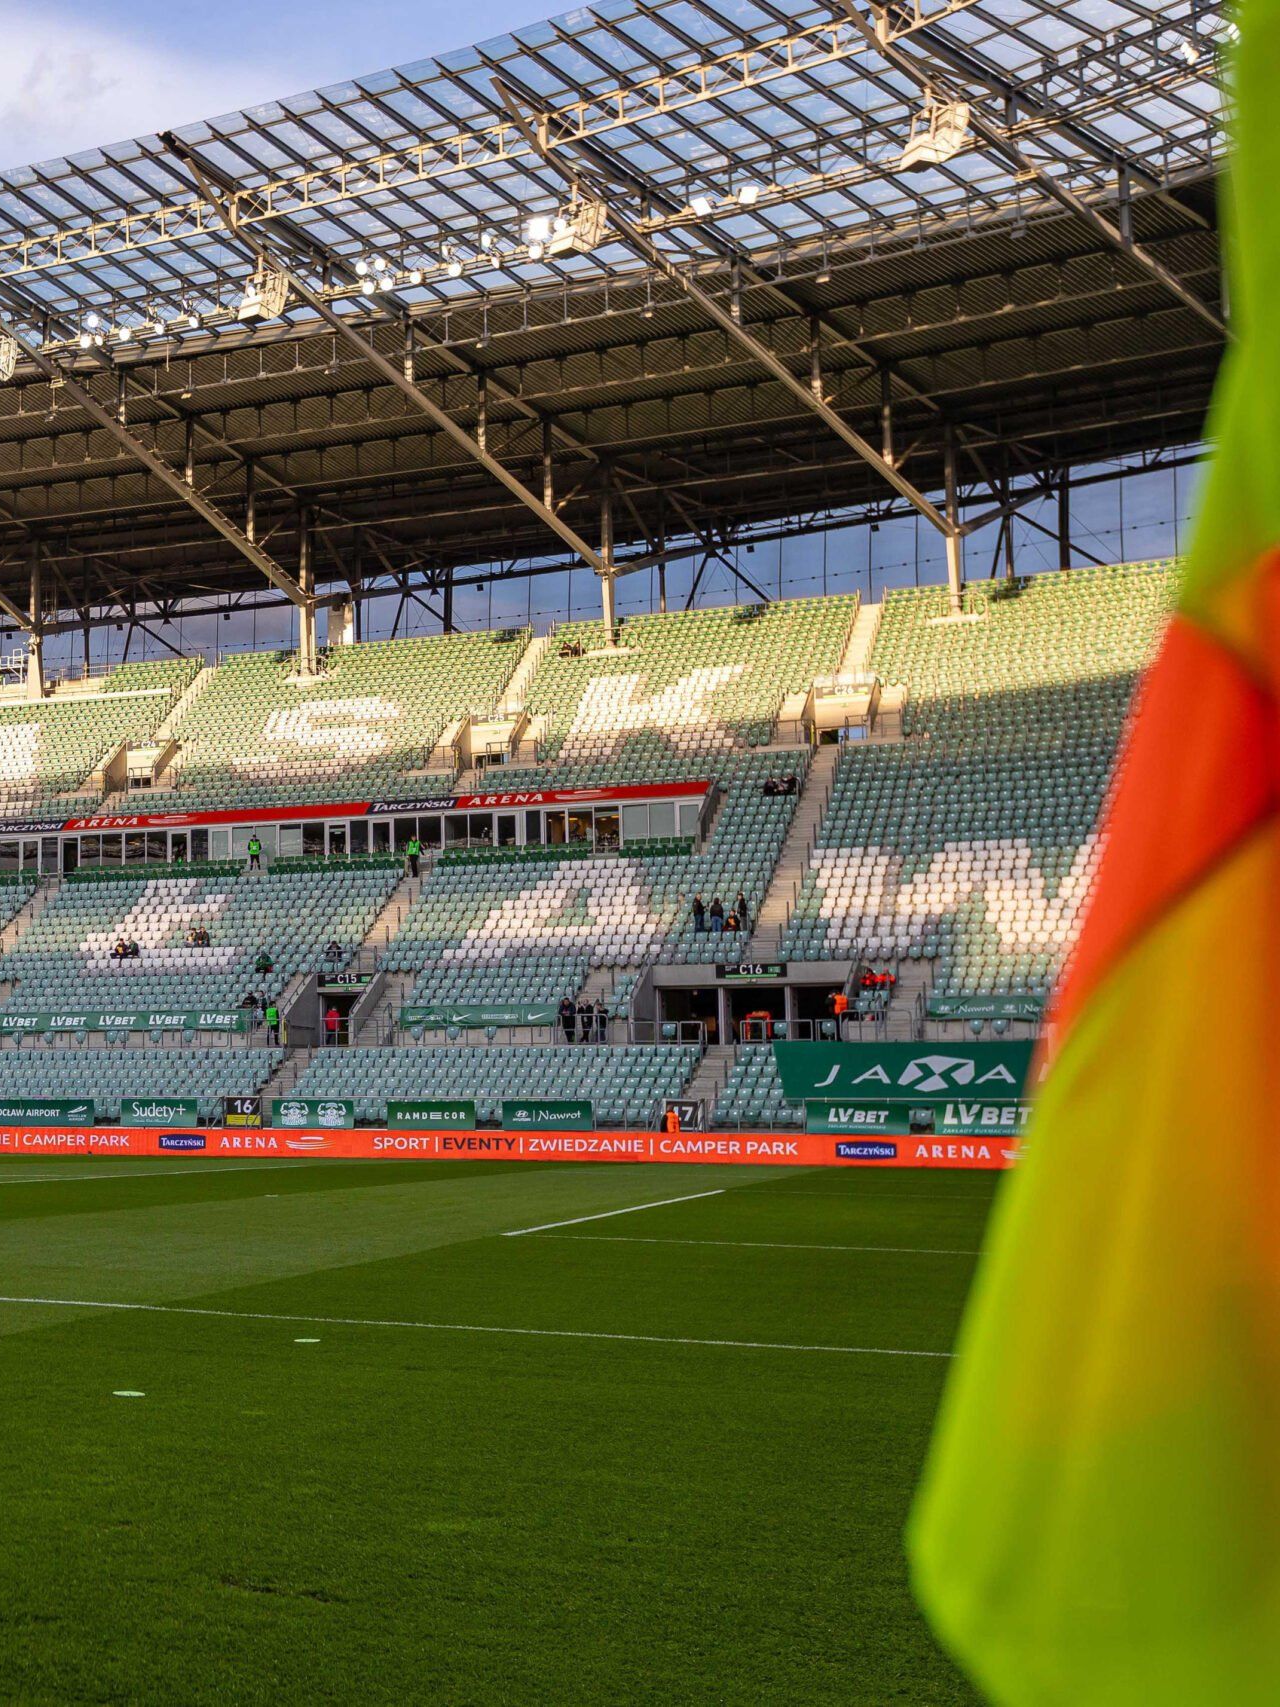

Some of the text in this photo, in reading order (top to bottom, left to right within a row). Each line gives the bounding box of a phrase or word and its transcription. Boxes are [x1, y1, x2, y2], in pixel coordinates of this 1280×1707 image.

[835, 685, 854, 695] C26
[487, 714, 505, 723] C25
[371, 794, 543, 812] TARCZYŃSKI ARENA
[74, 817, 138, 827] ARENA
[739, 964, 763, 974] C16
[337, 974, 357, 984] C15
[813, 1054, 1050, 1092] JAXA
[233, 1099, 252, 1113] 16
[25, 1109, 61, 1118] AIRPORT
[537, 1110, 582, 1122] Nawrot
[22, 1134, 86, 1146] CAMPER
[89, 1135, 130, 1146] PARK
[161, 1136, 278, 1149] TARCZYŃSKI ARENA
[373, 1137, 799, 1155] SPORT EVENTY ZWIEDZANIE CAMPER PARK
[838, 1144, 991, 1159] TARCZYŃSKI ARENA
